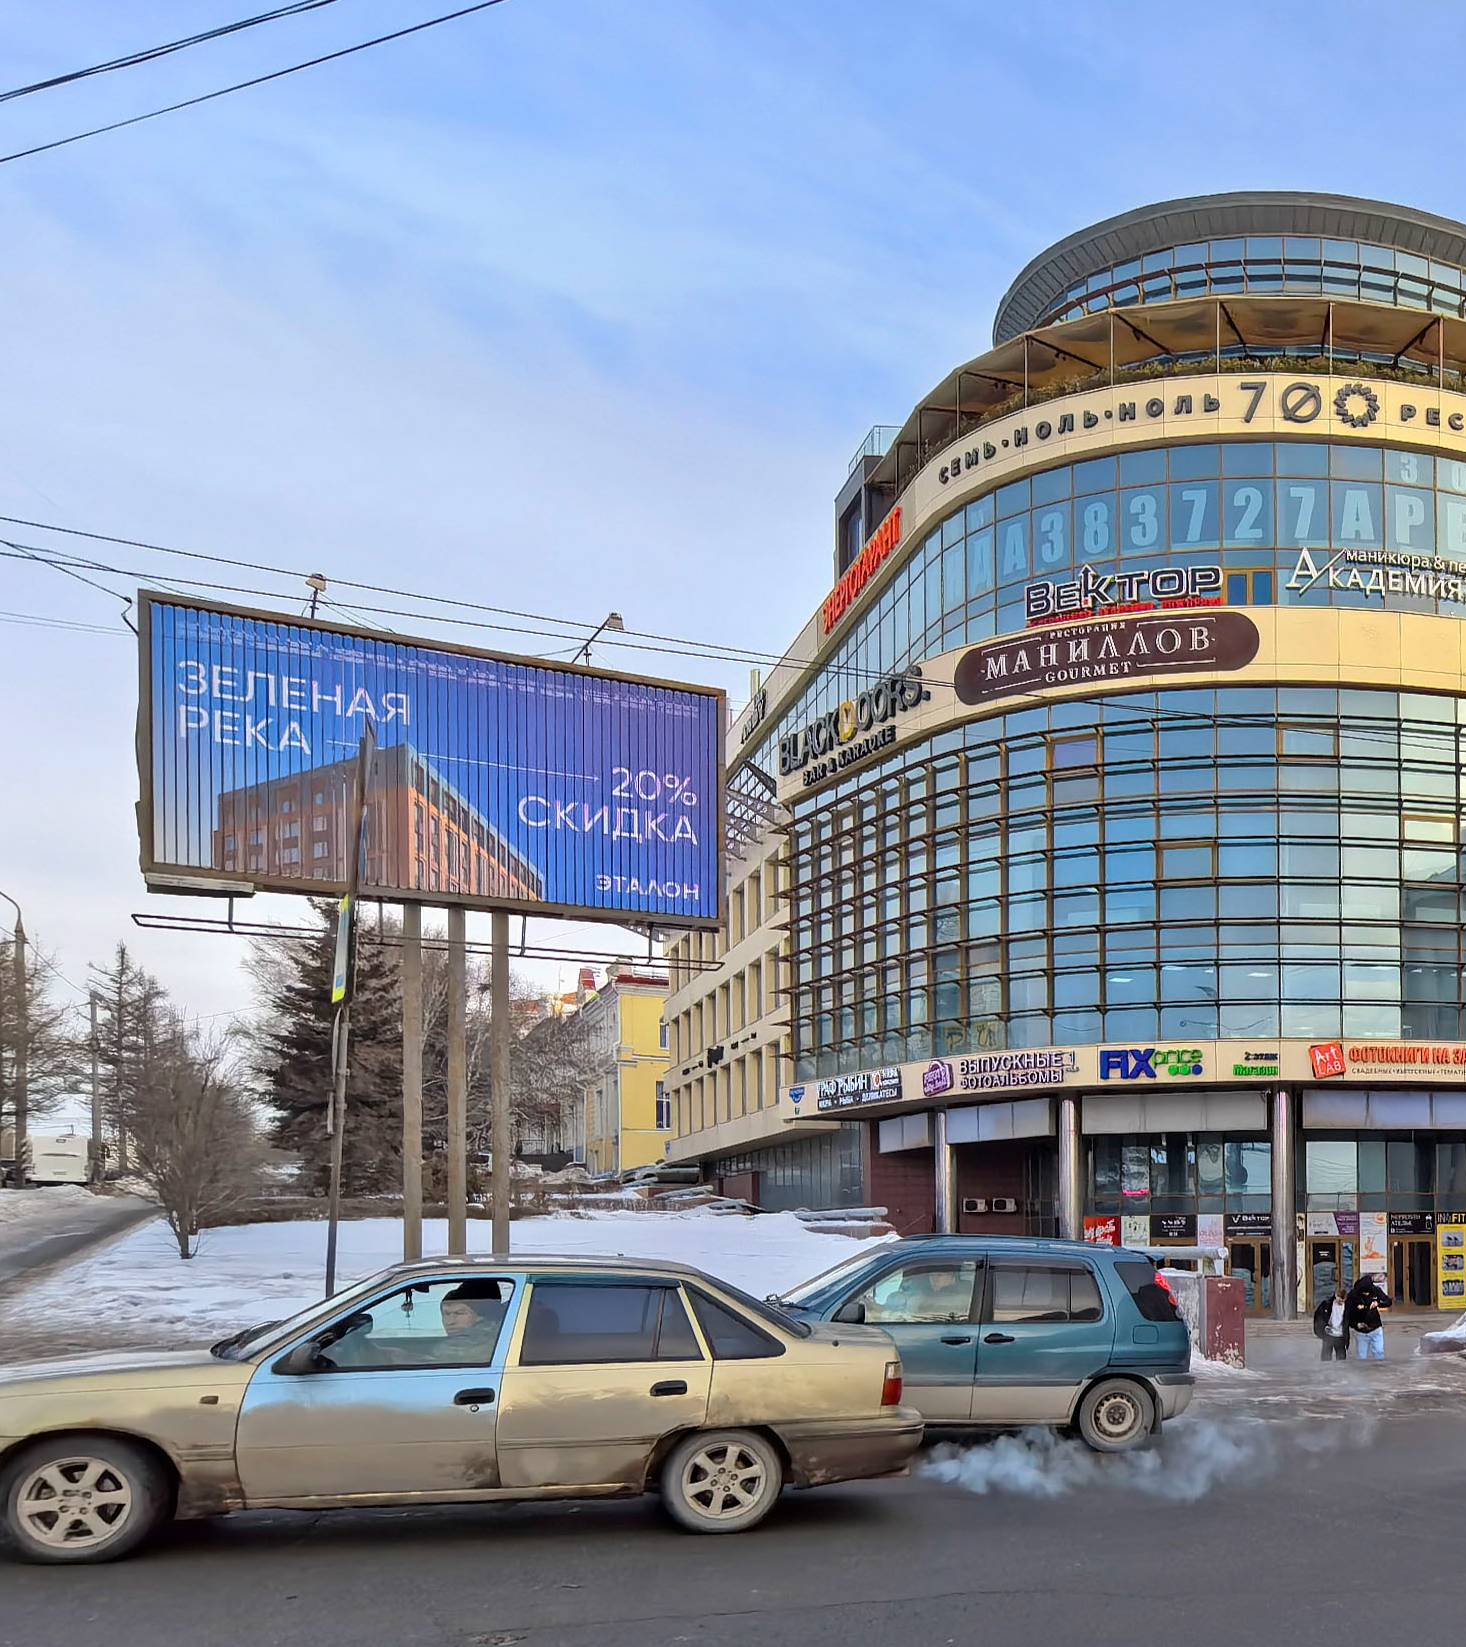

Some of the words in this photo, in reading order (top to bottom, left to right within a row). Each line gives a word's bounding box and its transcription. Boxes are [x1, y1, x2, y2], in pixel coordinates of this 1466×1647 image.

[938, 441, 997, 484] СЕМЬ
[1014, 411, 1099, 447] НОЛЬ
[1118, 393, 1221, 421] НОЛЬ
[1346, 550, 1430, 570] маникюра
[1434, 555, 1446, 571] &
[1025, 564, 1224, 620] ВЕКТОР
[984, 626, 1212, 681] МАНИЛЛОВ
[1045, 661, 1132, 683] GOURMET
[177, 660, 411, 727] ЗЕЛЕНАЯ
[178, 704, 311, 756] РЕКА
[612, 766, 698, 807] 20%
[518, 795, 698, 846] СКИДКА
[596, 873, 699, 901] ЭТАЛОН
[960, 1051, 1064, 1075] ВЫПУСКНЫЕ
[1100, 1048, 1157, 1080] FIX
[1314, 1045, 1338, 1065] Art
[1349, 1046, 1430, 1065] ФОТОКНИГИ
[1432, 1047, 1449, 1064] НА
[960, 1070, 1064, 1089] ФОТОАЛЬБОМЫ
